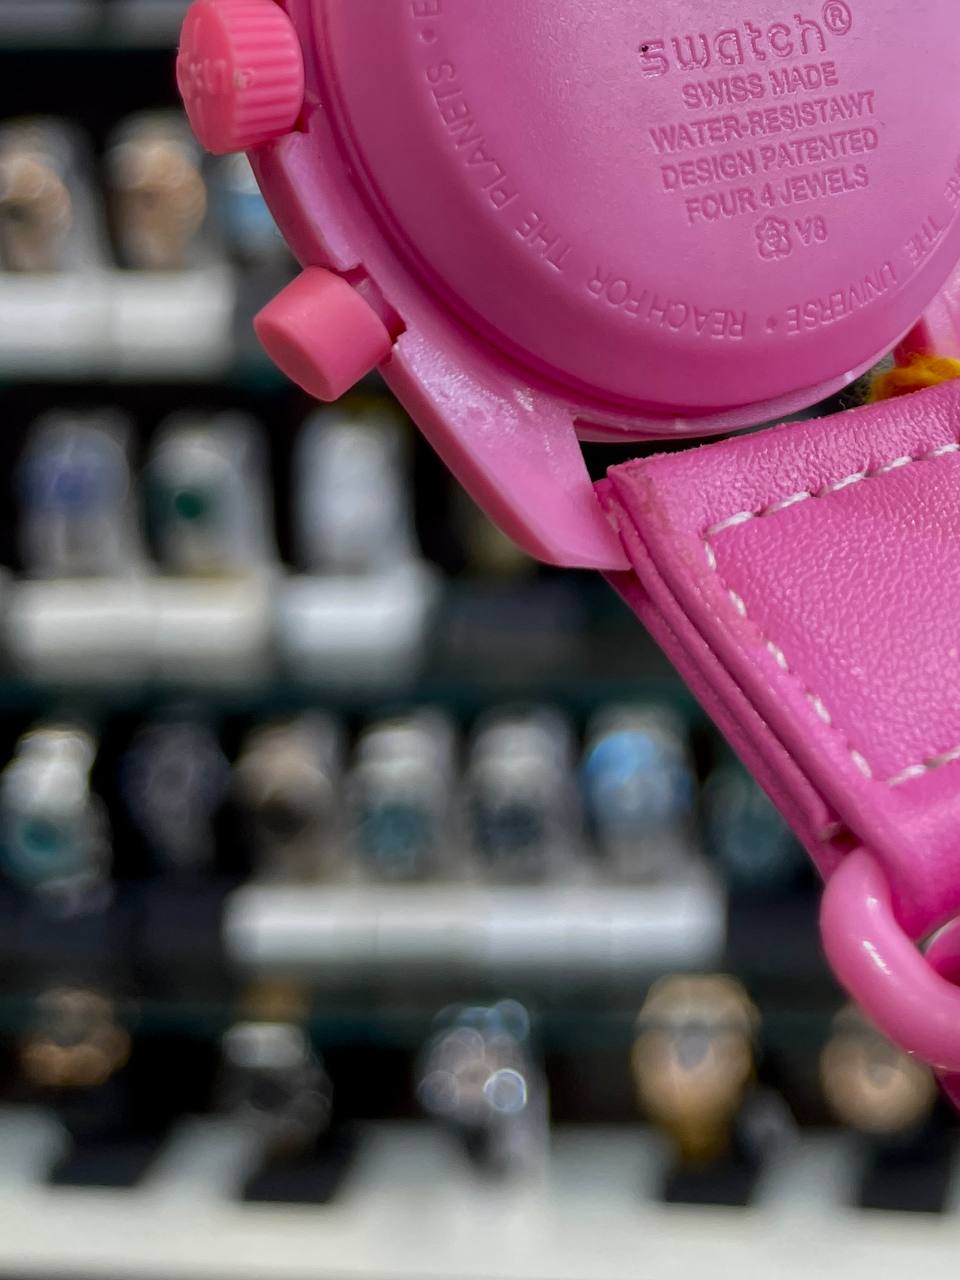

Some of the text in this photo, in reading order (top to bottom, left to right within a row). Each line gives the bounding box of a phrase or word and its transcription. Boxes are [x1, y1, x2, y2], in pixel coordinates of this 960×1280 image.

[681, 60, 839, 110] SWISS MADE
[649, 89, 877, 154] WATER-RESISTANT
[661, 125, 879, 192] DESIGN PATENTED
[424, 62, 747, 340] REACH FOR THE PLANETS
[685, 162, 870, 224] FOUR 4 JEWELS
